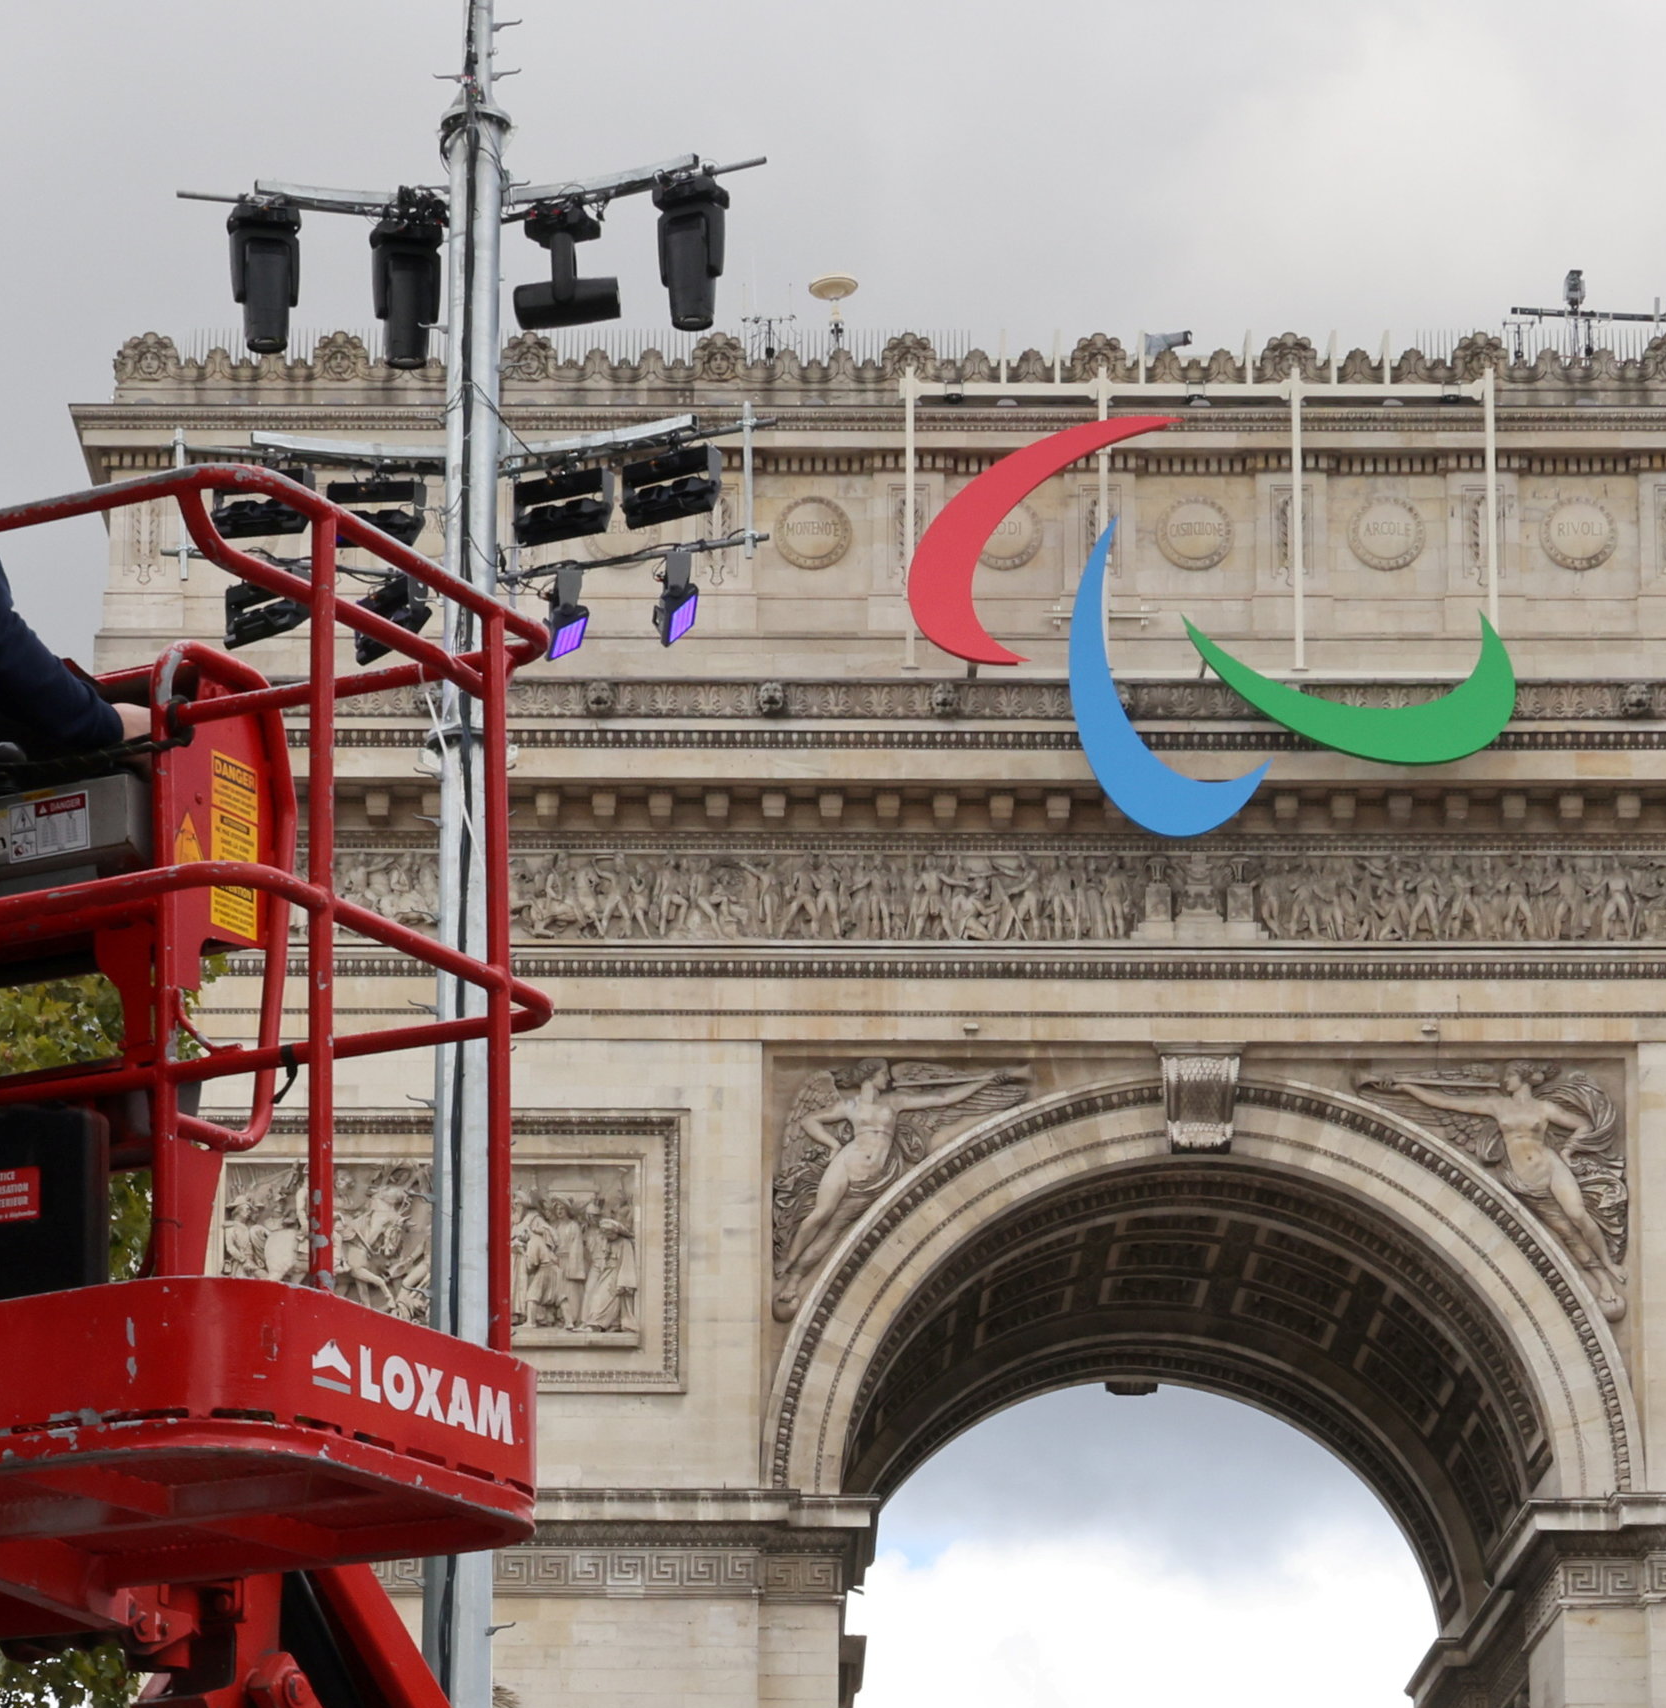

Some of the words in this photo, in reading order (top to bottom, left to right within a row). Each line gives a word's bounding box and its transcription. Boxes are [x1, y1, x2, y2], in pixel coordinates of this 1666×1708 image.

[991, 520, 1022, 537] ODI
[1363, 521, 1412, 537] ARCOLE
[1557, 521, 1603, 537] RIVOLI
[214, 758, 256, 792] DANGER
[50, 798, 81, 812] DANGER
[360, 1344, 514, 1445] LOXAM
